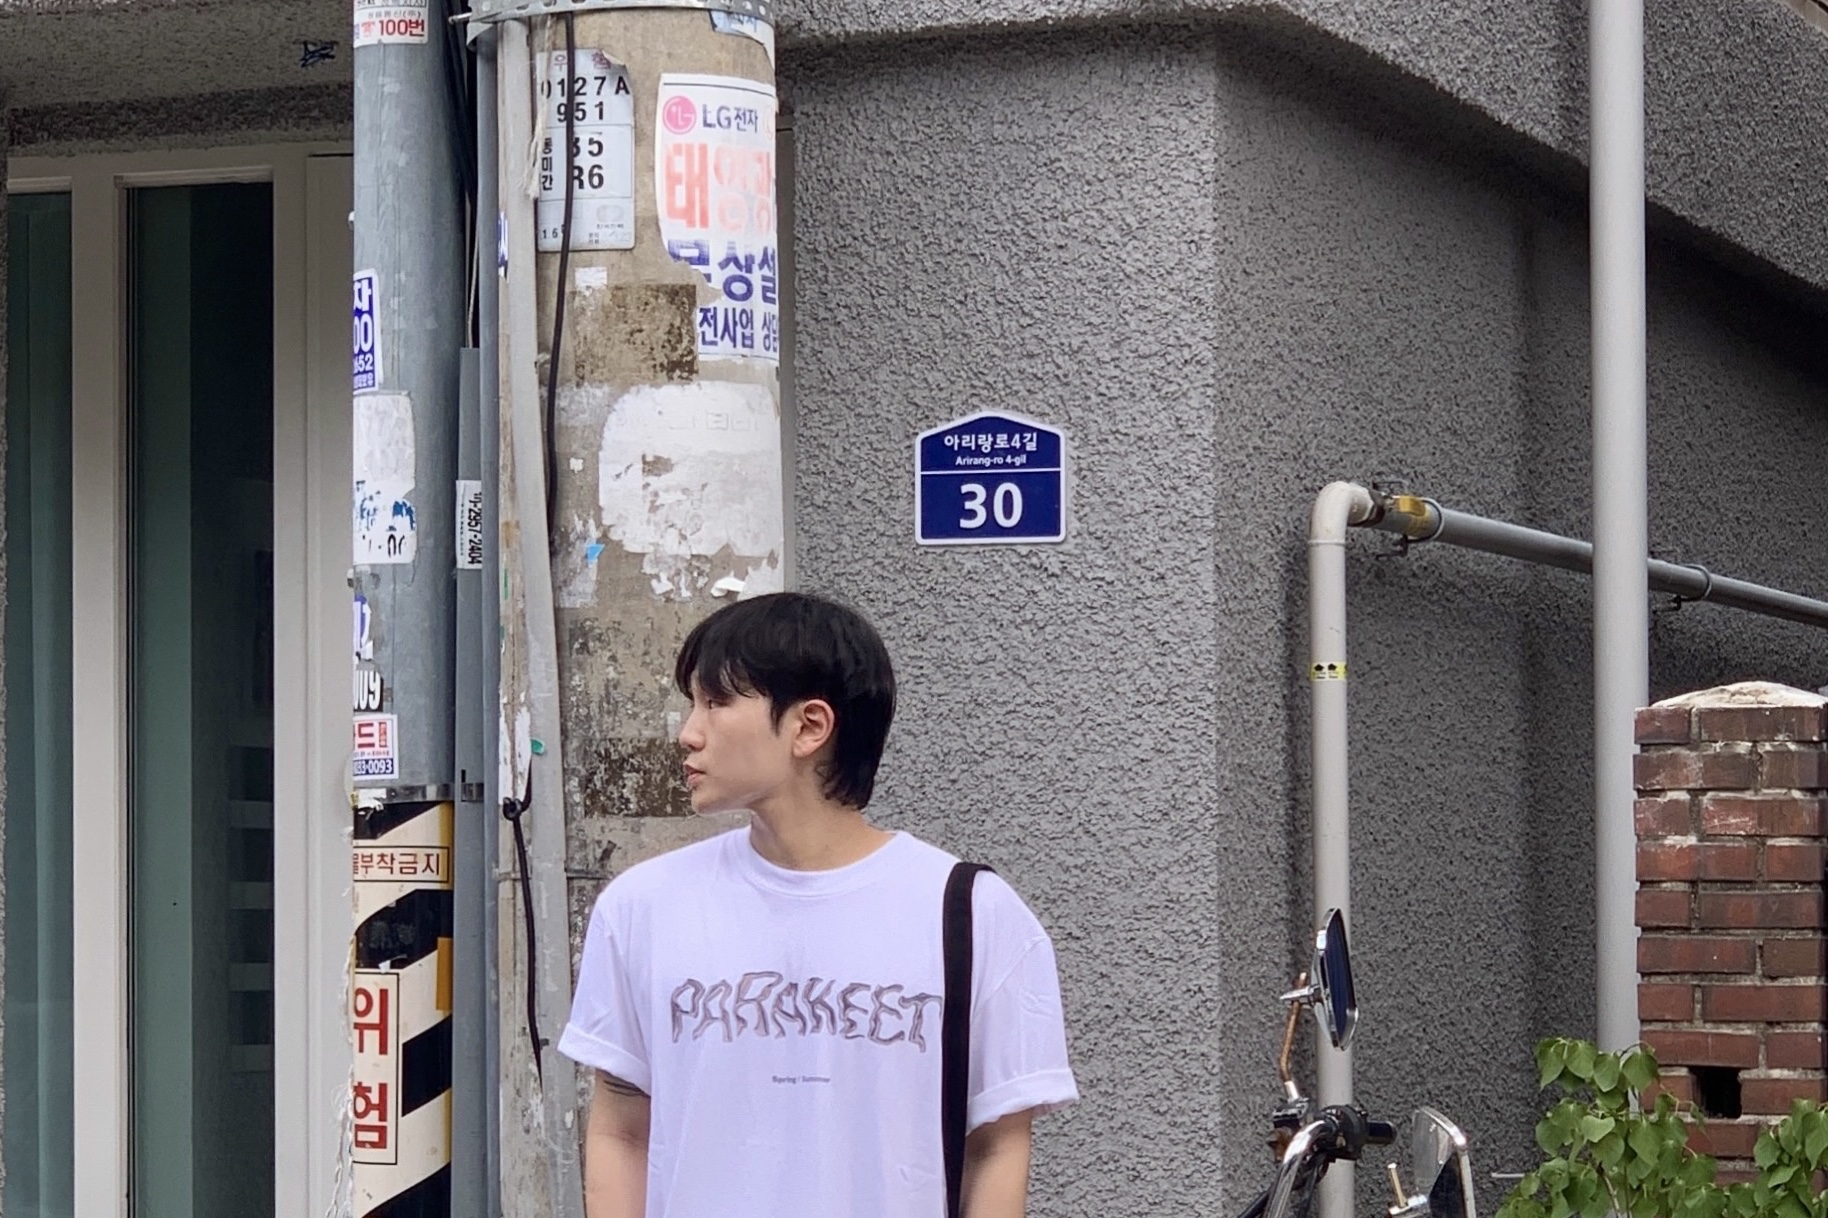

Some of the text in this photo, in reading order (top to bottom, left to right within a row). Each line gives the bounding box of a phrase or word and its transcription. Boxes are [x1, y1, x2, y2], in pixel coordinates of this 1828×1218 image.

[943, 432, 1038, 454] 아리랑로4길
[955, 454, 1027, 468] Arirang-ro 4-gil
[959, 482, 1023, 529] 30
[670, 970, 944, 1054] PARAKEET
